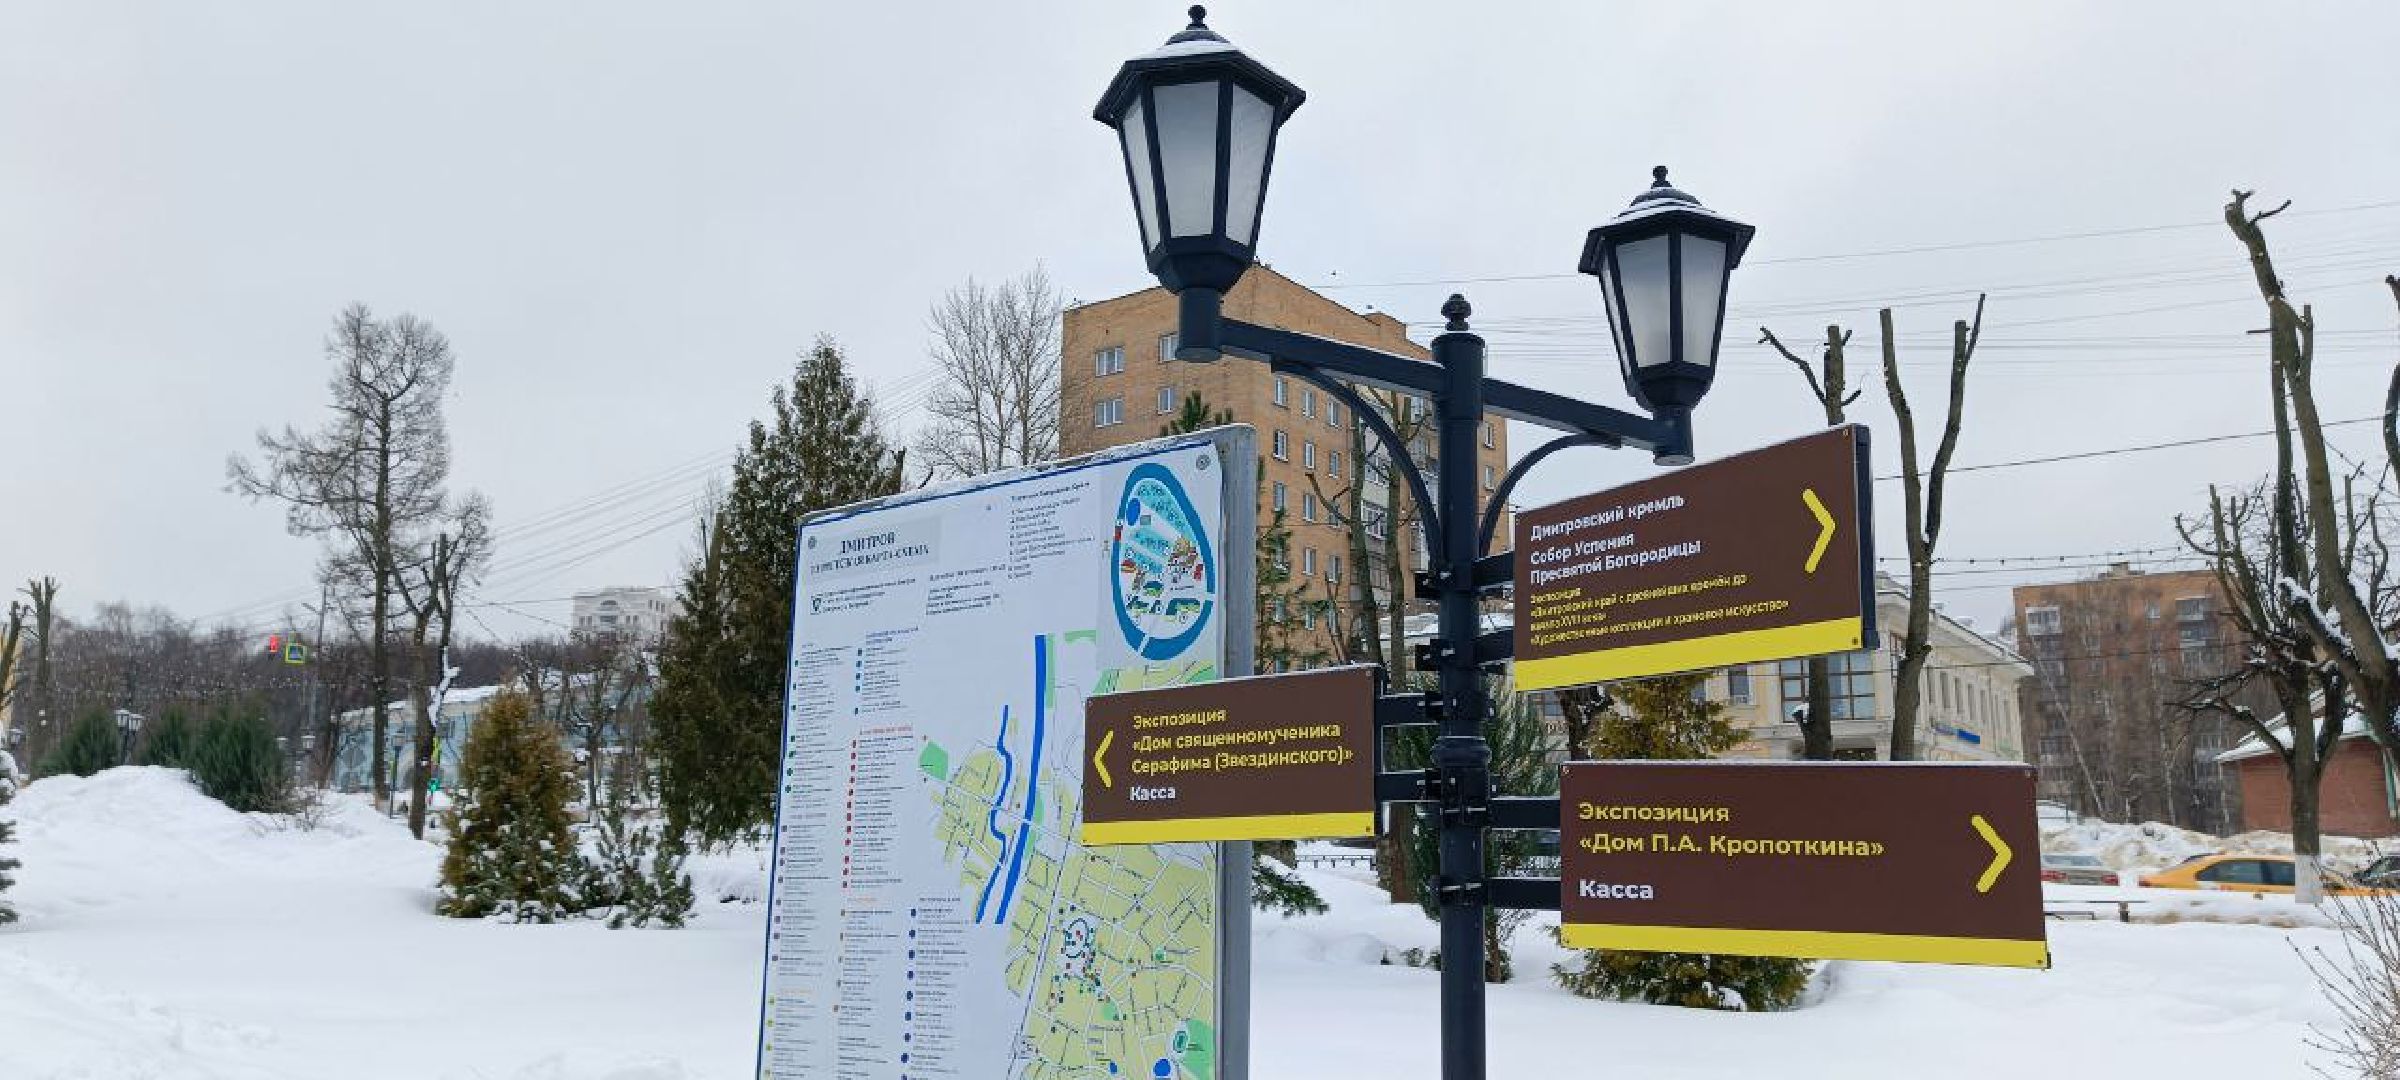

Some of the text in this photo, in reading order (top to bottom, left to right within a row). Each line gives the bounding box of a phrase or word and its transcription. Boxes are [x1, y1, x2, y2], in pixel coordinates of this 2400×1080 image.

[1531, 495, 1684, 541] Дмитровский кремль
[1531, 533, 1634, 565] Собор Успения
[1531, 540, 1701, 586] Пресвятой Богородицы
[1530, 587, 1581, 604] Экспозиция
[1530, 598, 1593, 618] «Дмитровский
[1594, 593, 1617, 609] край
[1626, 585, 1689, 604] древнейших
[1733, 574, 1748, 586] до
[1609, 617, 1664, 634] коллекции
[1665, 615, 1671, 625] и
[1673, 608, 1724, 626] храмовое
[1725, 600, 1789, 617] искусство»
[1133, 709, 1227, 730] Экспозиция
[1133, 724, 1341, 753] «Дом священномученика
[1131, 746, 1353, 777] Серафима (Звездинского)»
[1129, 785, 1176, 801] Касса
[1578, 802, 1731, 824] Экспозиция
[1579, 833, 1885, 857] «Дом П.А. Кропоткина»
[1578, 878, 1654, 900] Касса
